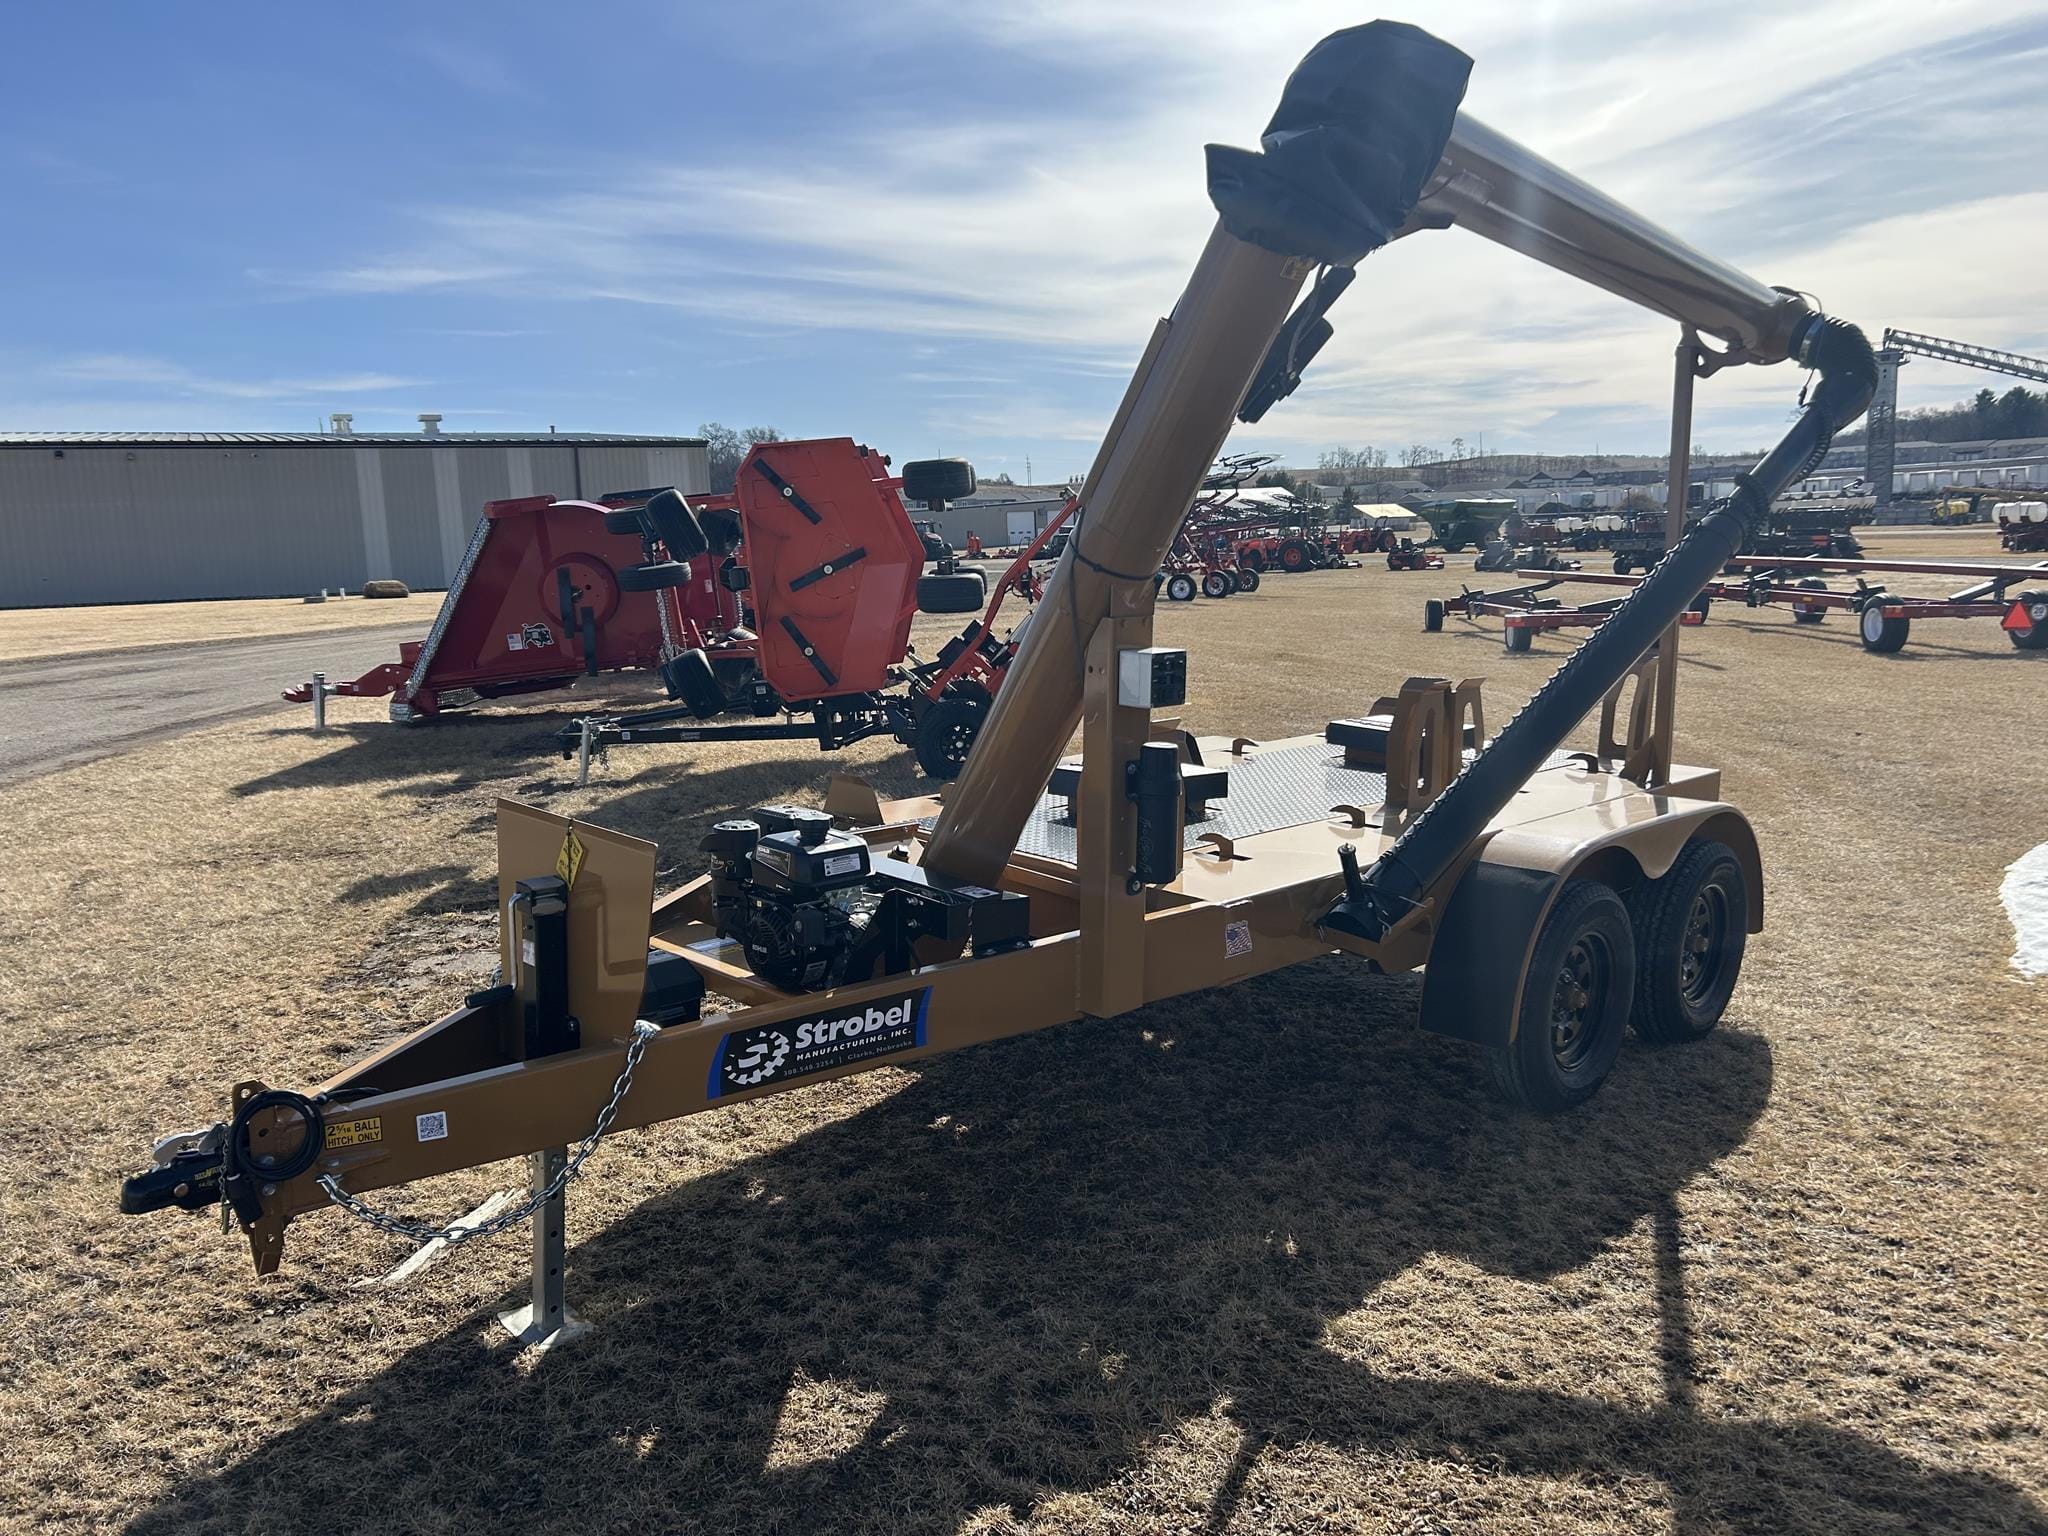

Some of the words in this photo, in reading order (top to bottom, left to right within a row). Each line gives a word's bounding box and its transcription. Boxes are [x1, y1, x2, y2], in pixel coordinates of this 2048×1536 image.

[795, 998, 912, 1049] Strobel
[796, 1034, 887, 1061] MANUFACTURING,
[890, 1027, 912, 1038] INC.
[876, 1040, 913, 1053] Nebraska
[354, 1121, 380, 1132] BALL
[327, 1135, 354, 1147] HITCH
[357, 1131, 380, 1143] ONLY
